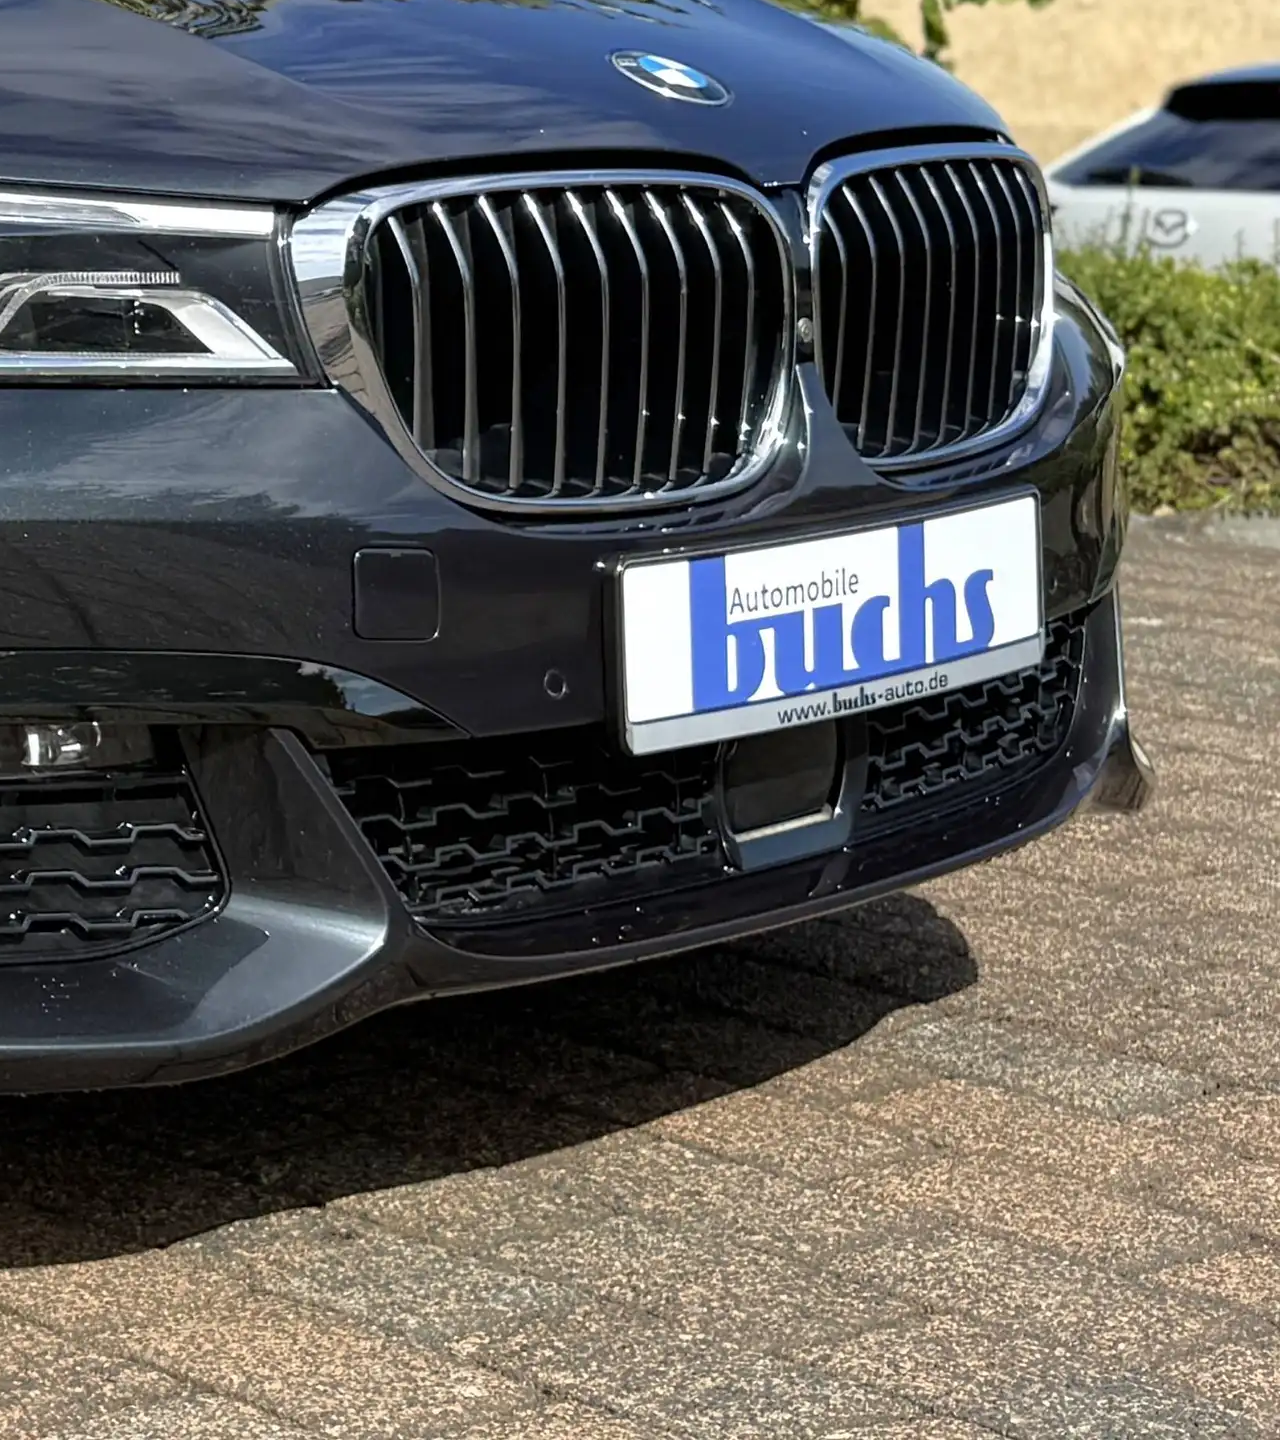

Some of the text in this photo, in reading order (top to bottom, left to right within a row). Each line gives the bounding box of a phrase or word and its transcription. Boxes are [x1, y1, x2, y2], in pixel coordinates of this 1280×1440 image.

[689, 522, 995, 713] buchs
[729, 568, 860, 615] Automobile
[777, 672, 949, 725] www.buchs-auto.de
